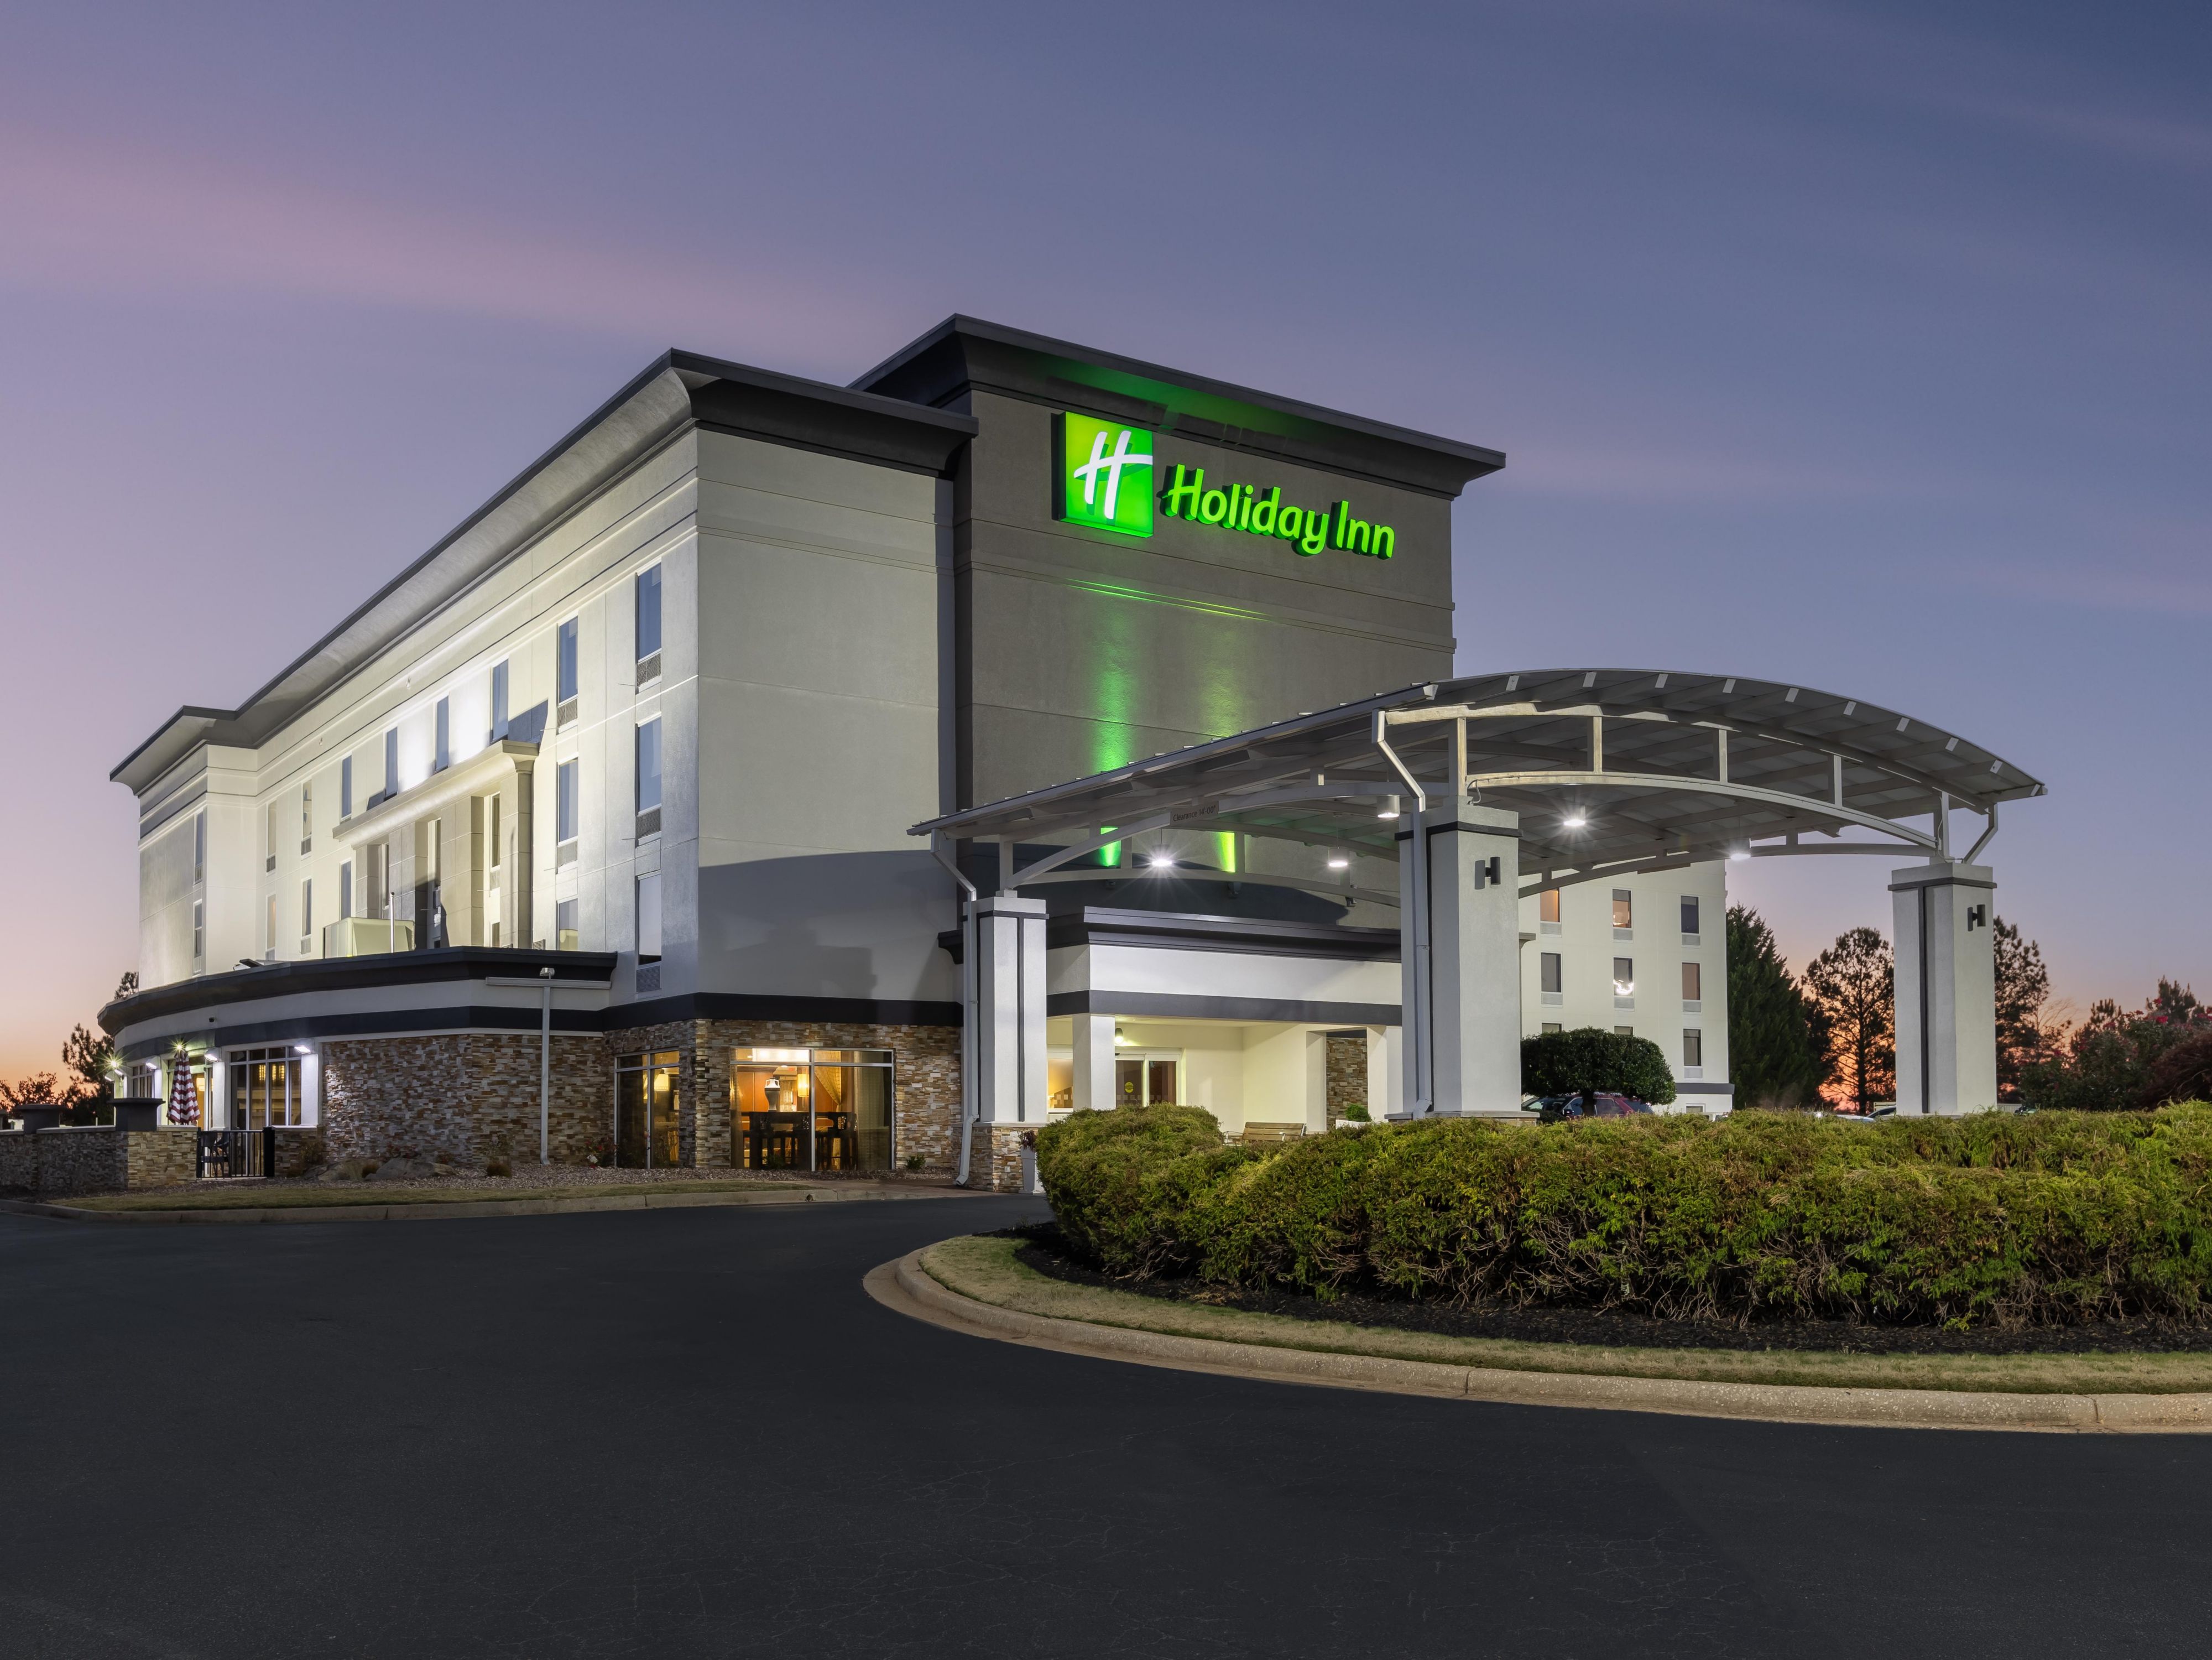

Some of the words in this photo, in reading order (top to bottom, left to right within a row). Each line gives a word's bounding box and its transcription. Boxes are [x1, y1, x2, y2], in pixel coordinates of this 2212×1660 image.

[1073, 430, 1153, 519] H
[1162, 464, 1329, 555] Holiday
[1336, 500, 1395, 558] Inn
